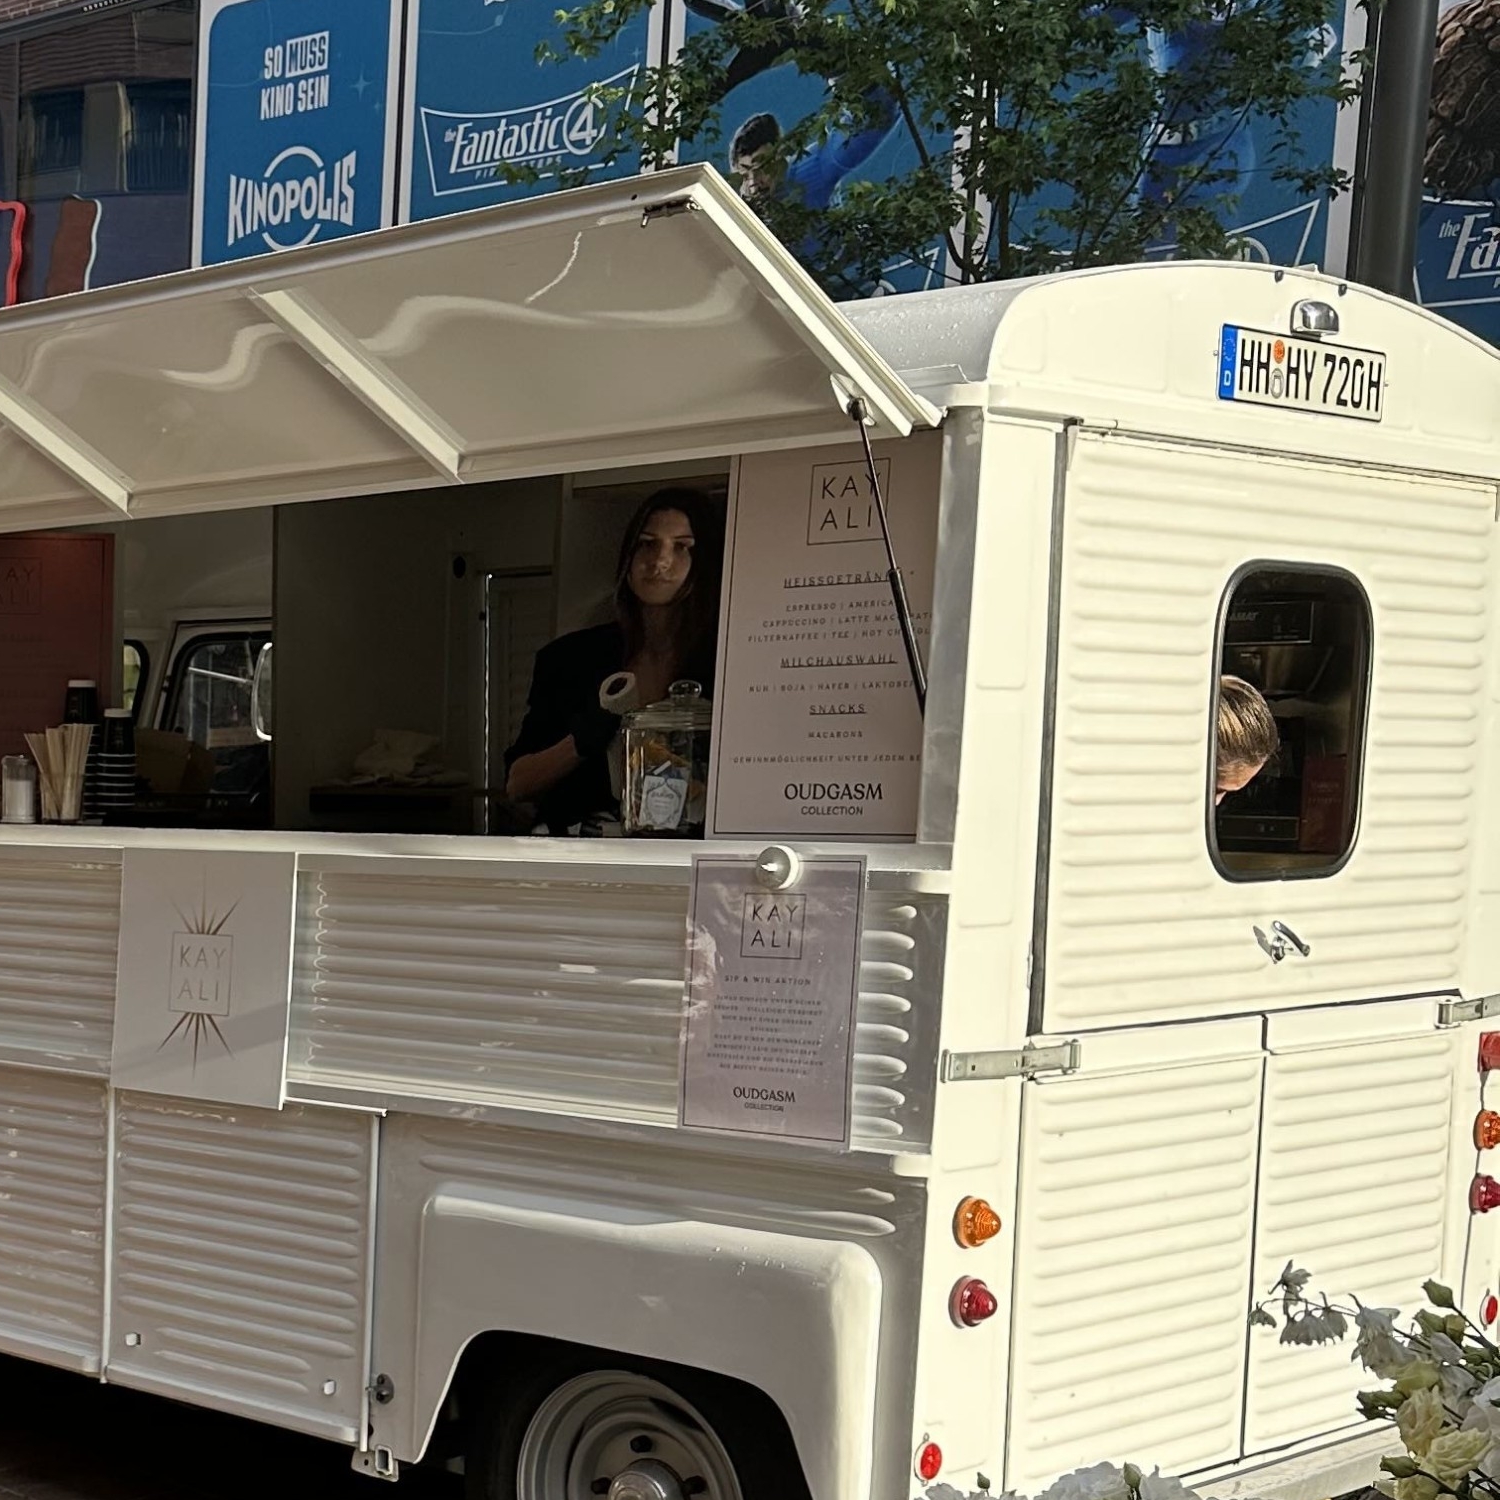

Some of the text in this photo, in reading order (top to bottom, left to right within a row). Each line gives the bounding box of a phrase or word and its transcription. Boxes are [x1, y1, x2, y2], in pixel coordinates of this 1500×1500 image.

[264, 34, 327, 79] SO MUSS
[260, 75, 329, 120] KINO SEIN
[449, 107, 565, 174] Fantastic
[227, 150, 357, 247] KINOPOLIS
[1438, 212, 1500, 280] the Fa
[1223, 338, 1383, 412] D HH HY 720H
[821, 472, 881, 499] KAY
[820, 506, 872, 531] ALI
[784, 569, 895, 589] HEISSGETRÄN
[786, 599, 895, 612] ESPRESSO AMERICA
[762, 617, 826, 628] CAPPUCCINO
[838, 615, 869, 625] LATTE
[748, 630, 819, 643] FILTERKAFFEE
[831, 630, 850, 640] TEE
[862, 628, 883, 639] HOT
[780, 653, 897, 668] MILCHAUSWAHL
[818, 682, 850, 691] HAFER
[809, 703, 867, 715] SNACKS
[808, 730, 863, 739] MACARONS
[838, 754, 869, 763] UNTER
[873, 754, 905, 763] JEDEM
[784, 782, 883, 801] OUDGASM
[800, 804, 864, 816] COLLECTION
[752, 903, 799, 923] KAY
[750, 929, 792, 948] ALI
[180, 944, 227, 969] KAY
[177, 979, 220, 1002] ALI
[733, 1086, 796, 1103] OUDGASM
[744, 1101, 785, 1112] COLLECTION
